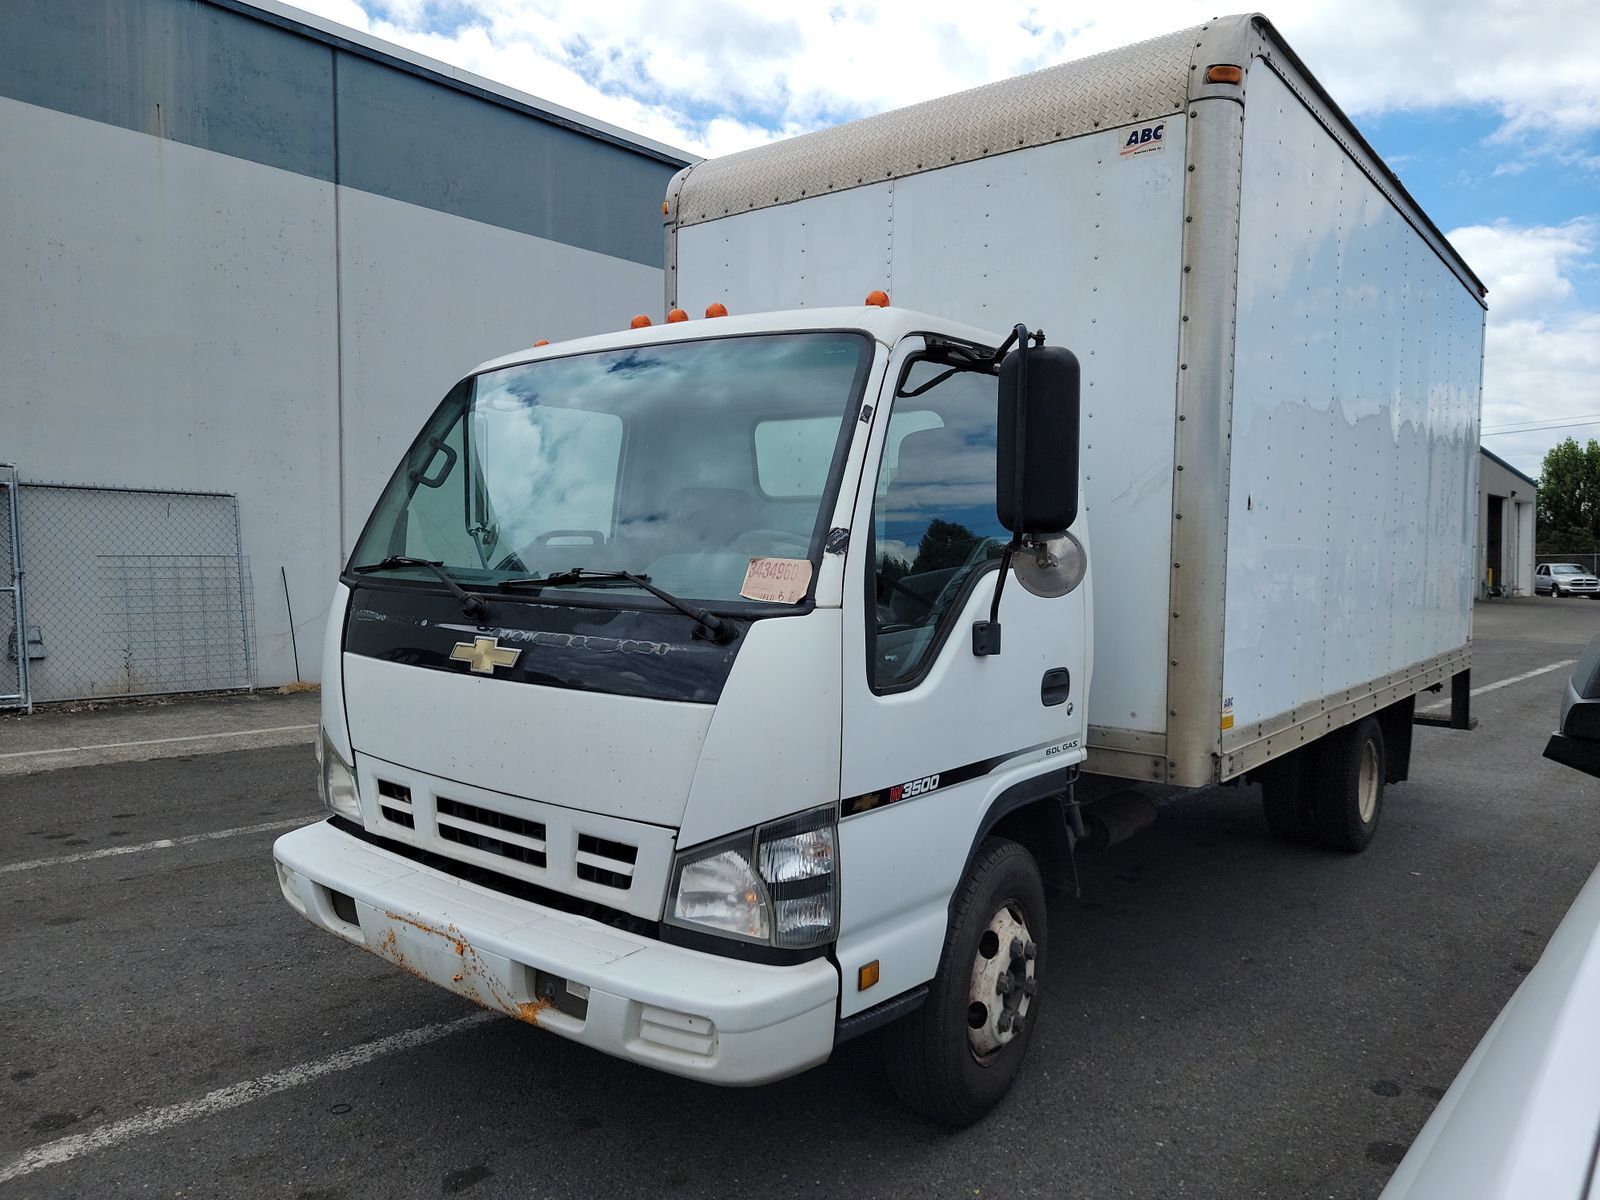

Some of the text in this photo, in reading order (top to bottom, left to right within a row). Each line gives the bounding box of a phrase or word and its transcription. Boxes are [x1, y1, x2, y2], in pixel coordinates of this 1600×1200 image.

[1125, 124, 1165, 146] ABC
[1062, 740, 1078, 750] GAS
[889, 774, 940, 803] W3500
